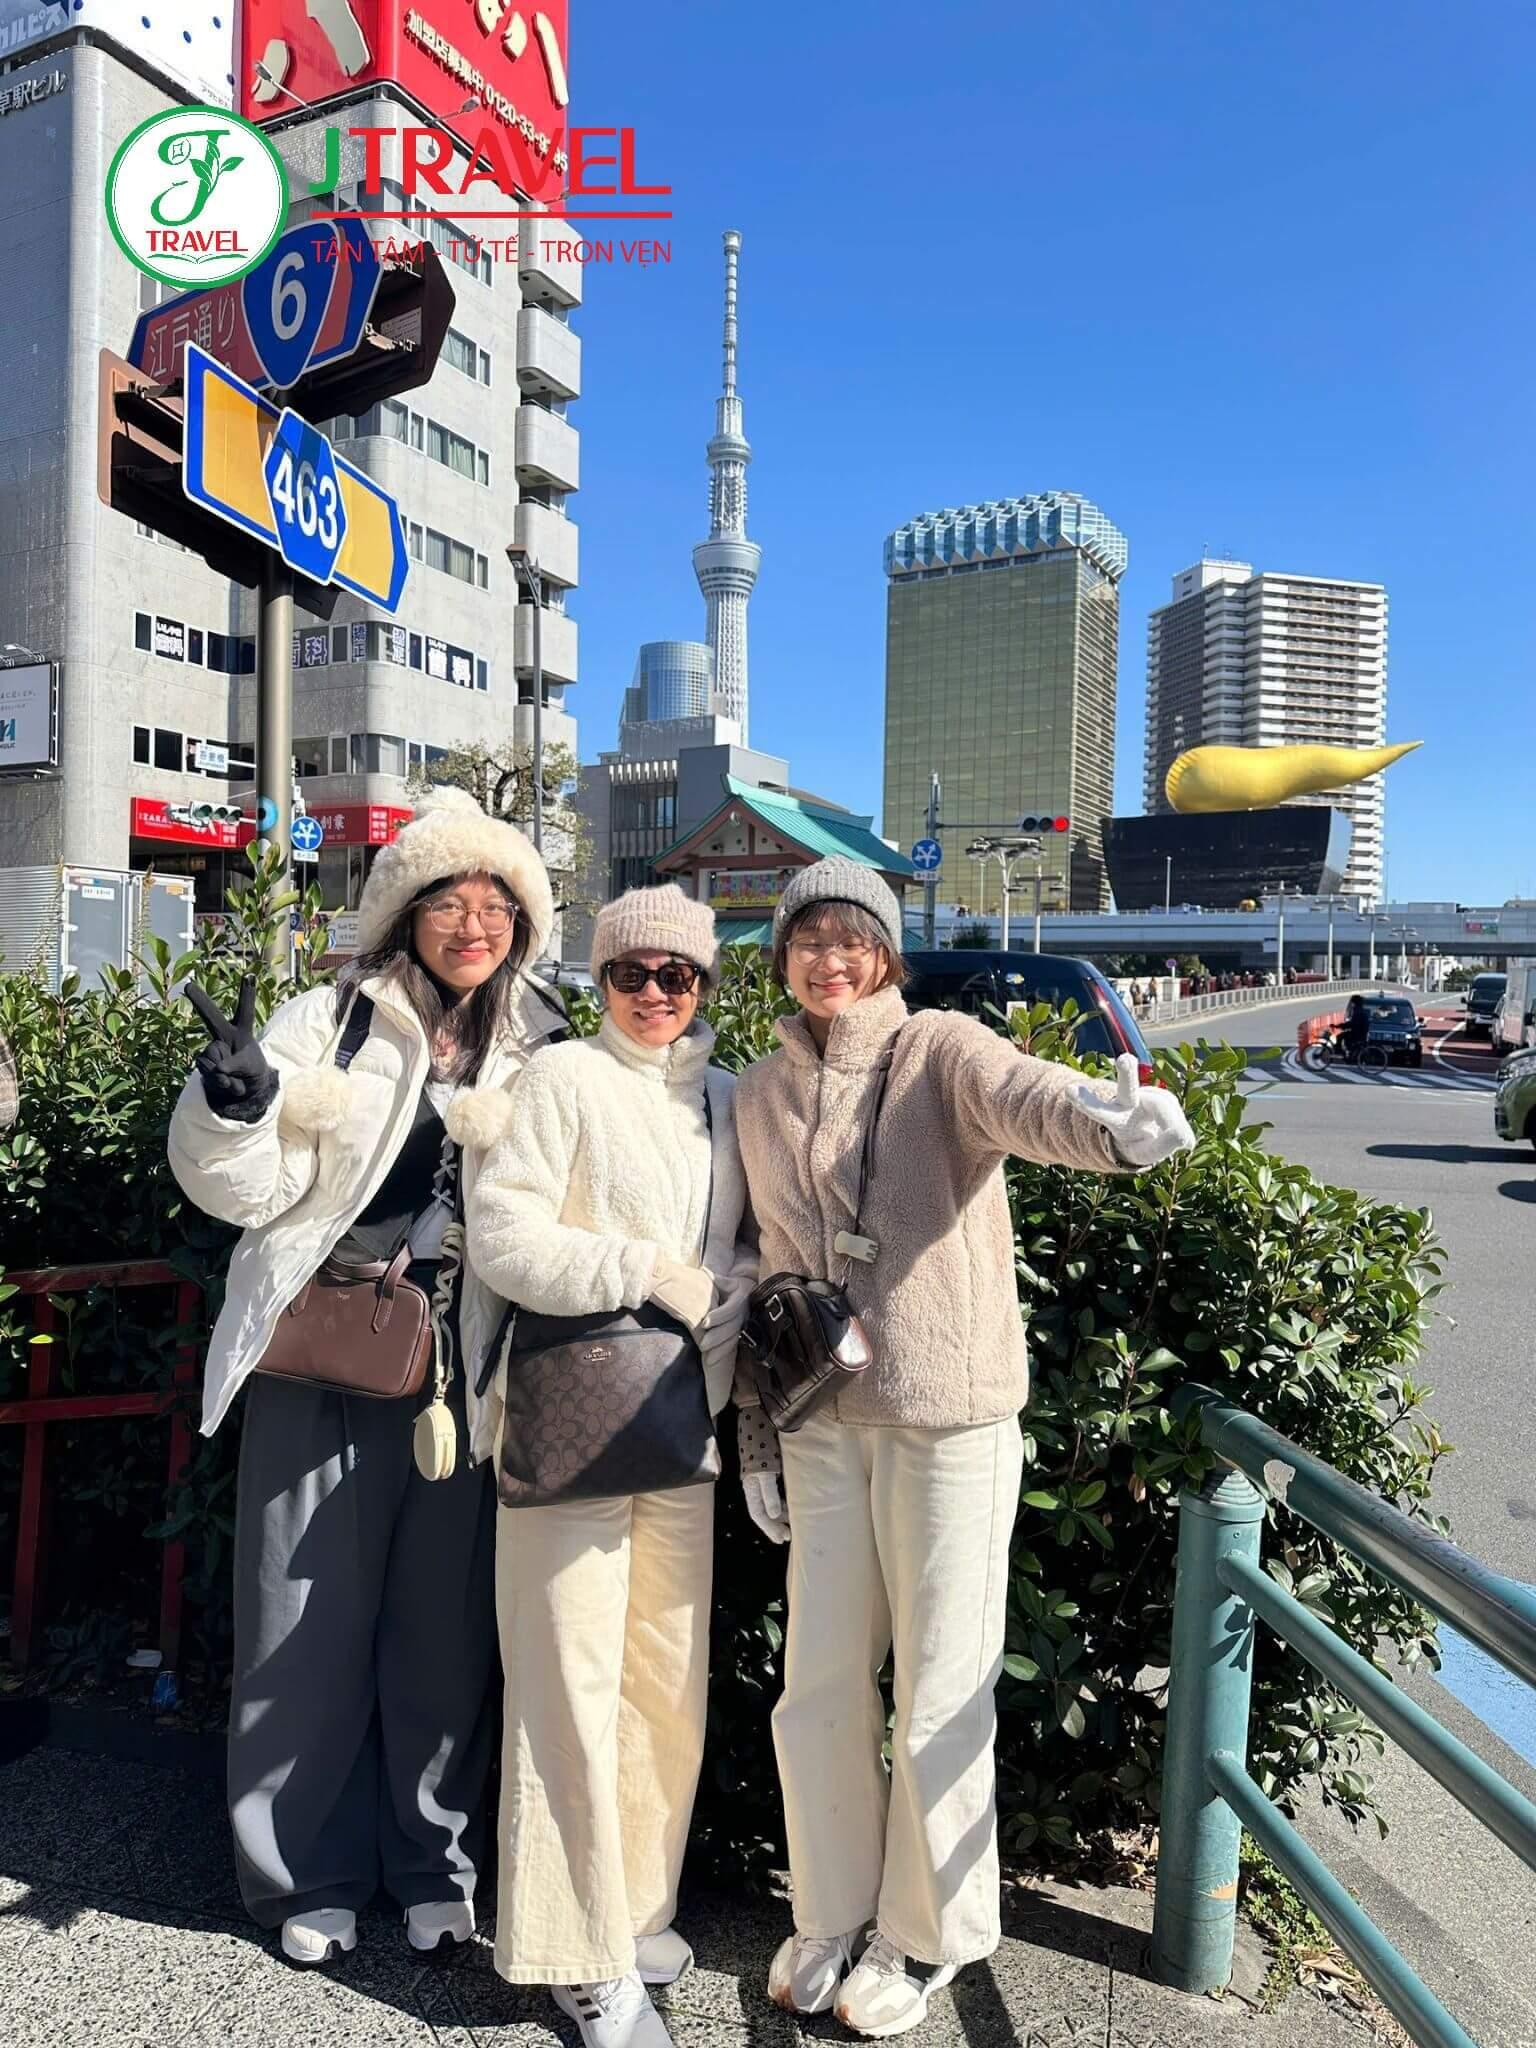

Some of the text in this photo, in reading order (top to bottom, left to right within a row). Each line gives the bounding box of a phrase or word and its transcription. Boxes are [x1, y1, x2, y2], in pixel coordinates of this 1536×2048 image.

[150, 290, 236, 378] 江戸通り
[271, 252, 308, 340] 6
[272, 449, 338, 550] 463
